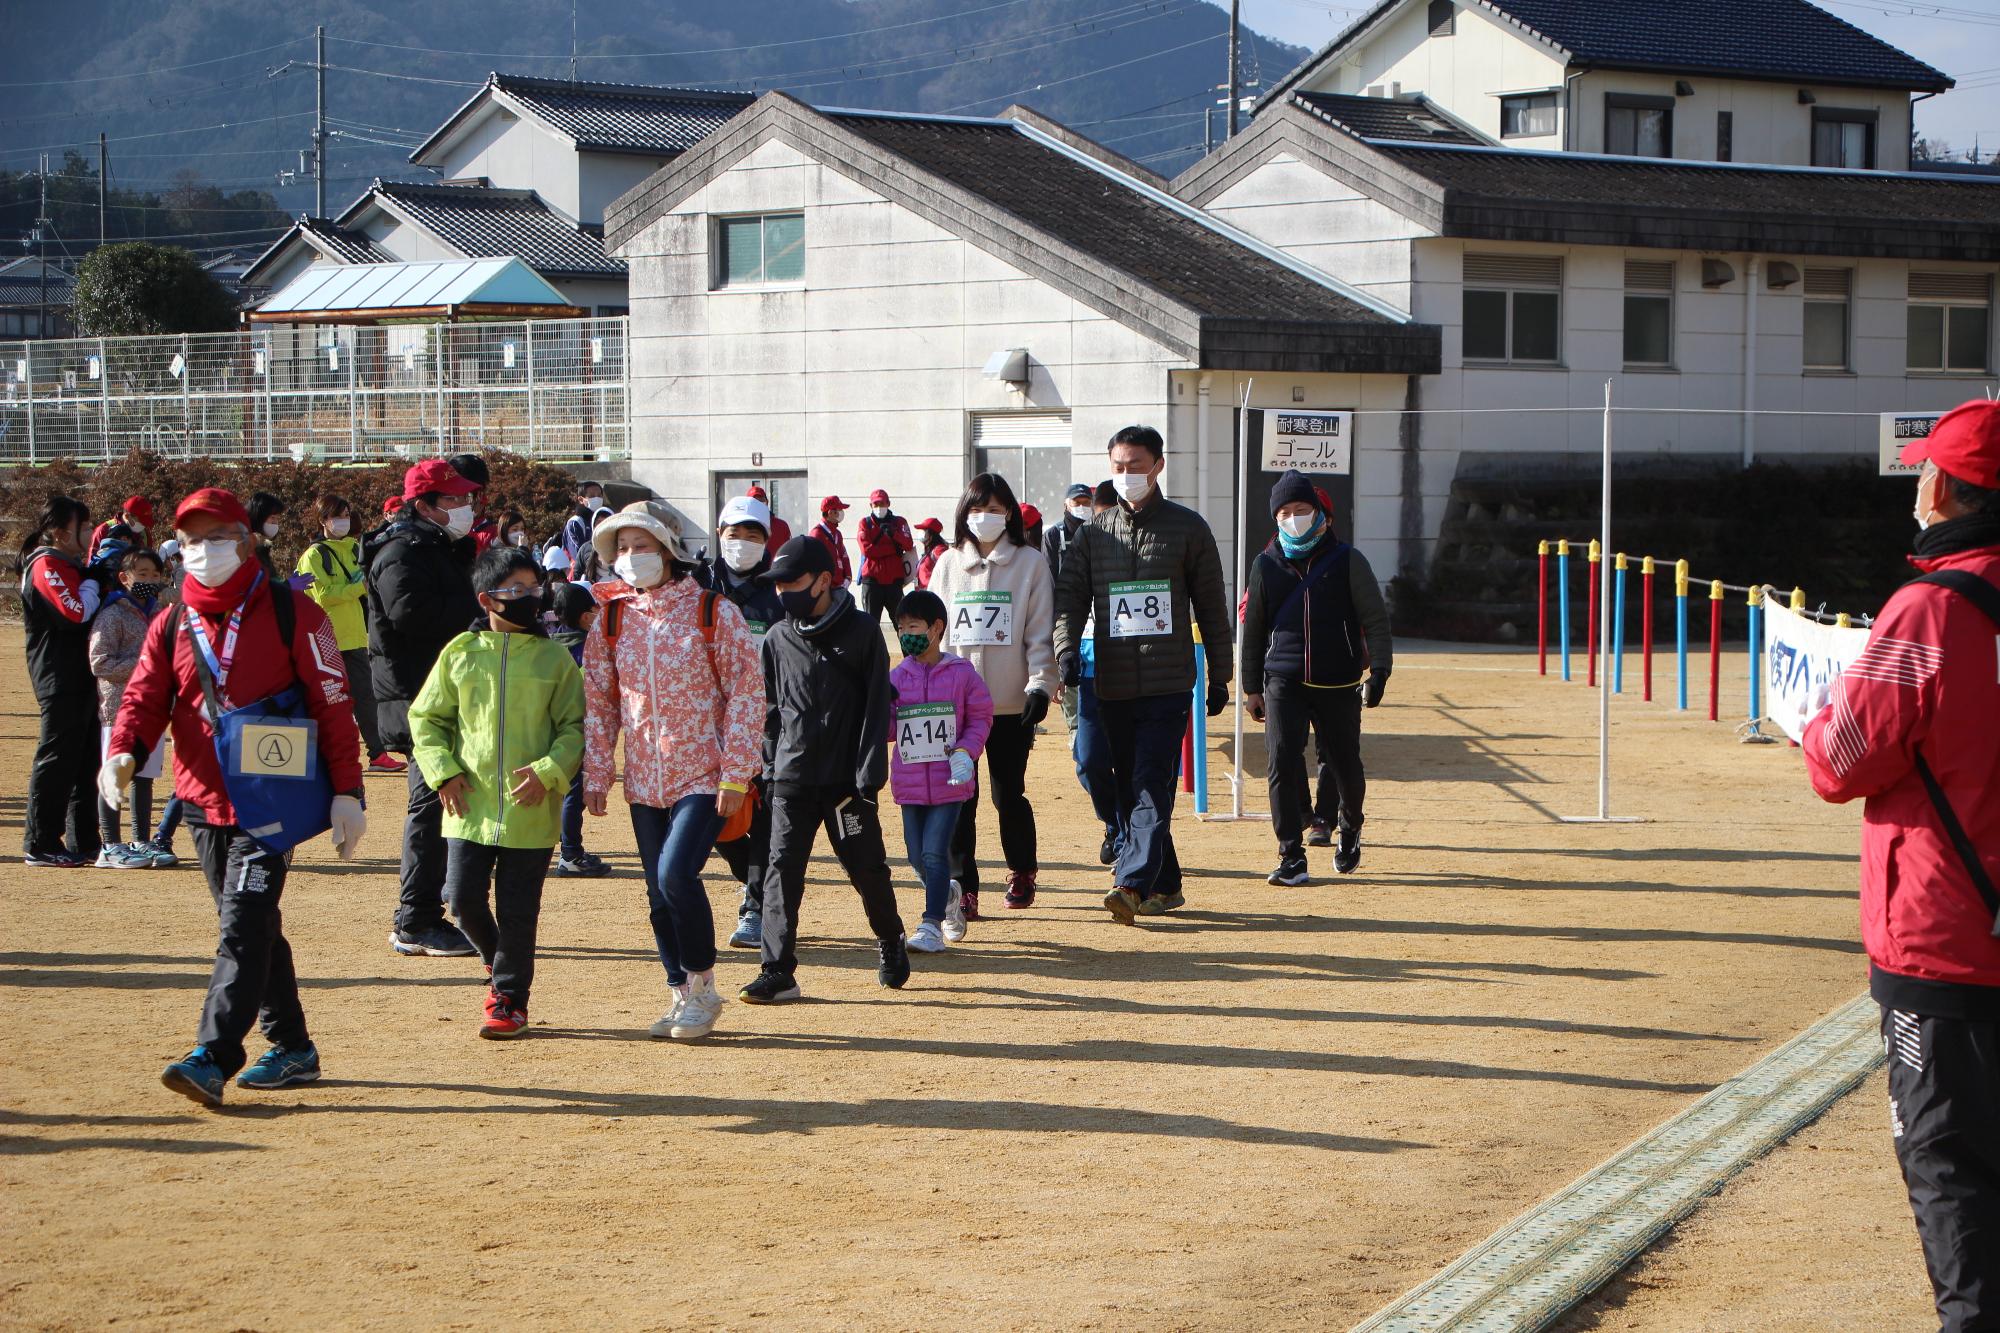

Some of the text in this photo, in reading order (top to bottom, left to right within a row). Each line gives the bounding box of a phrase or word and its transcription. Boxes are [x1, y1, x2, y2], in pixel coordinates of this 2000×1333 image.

[1277, 417, 1339, 435] 耐寒登山
[1277, 438, 1336, 459] ゴール
[954, 606, 1001, 629] A-7
[1114, 595, 1160, 621] A-8
[900, 719, 948, 747] A-14
